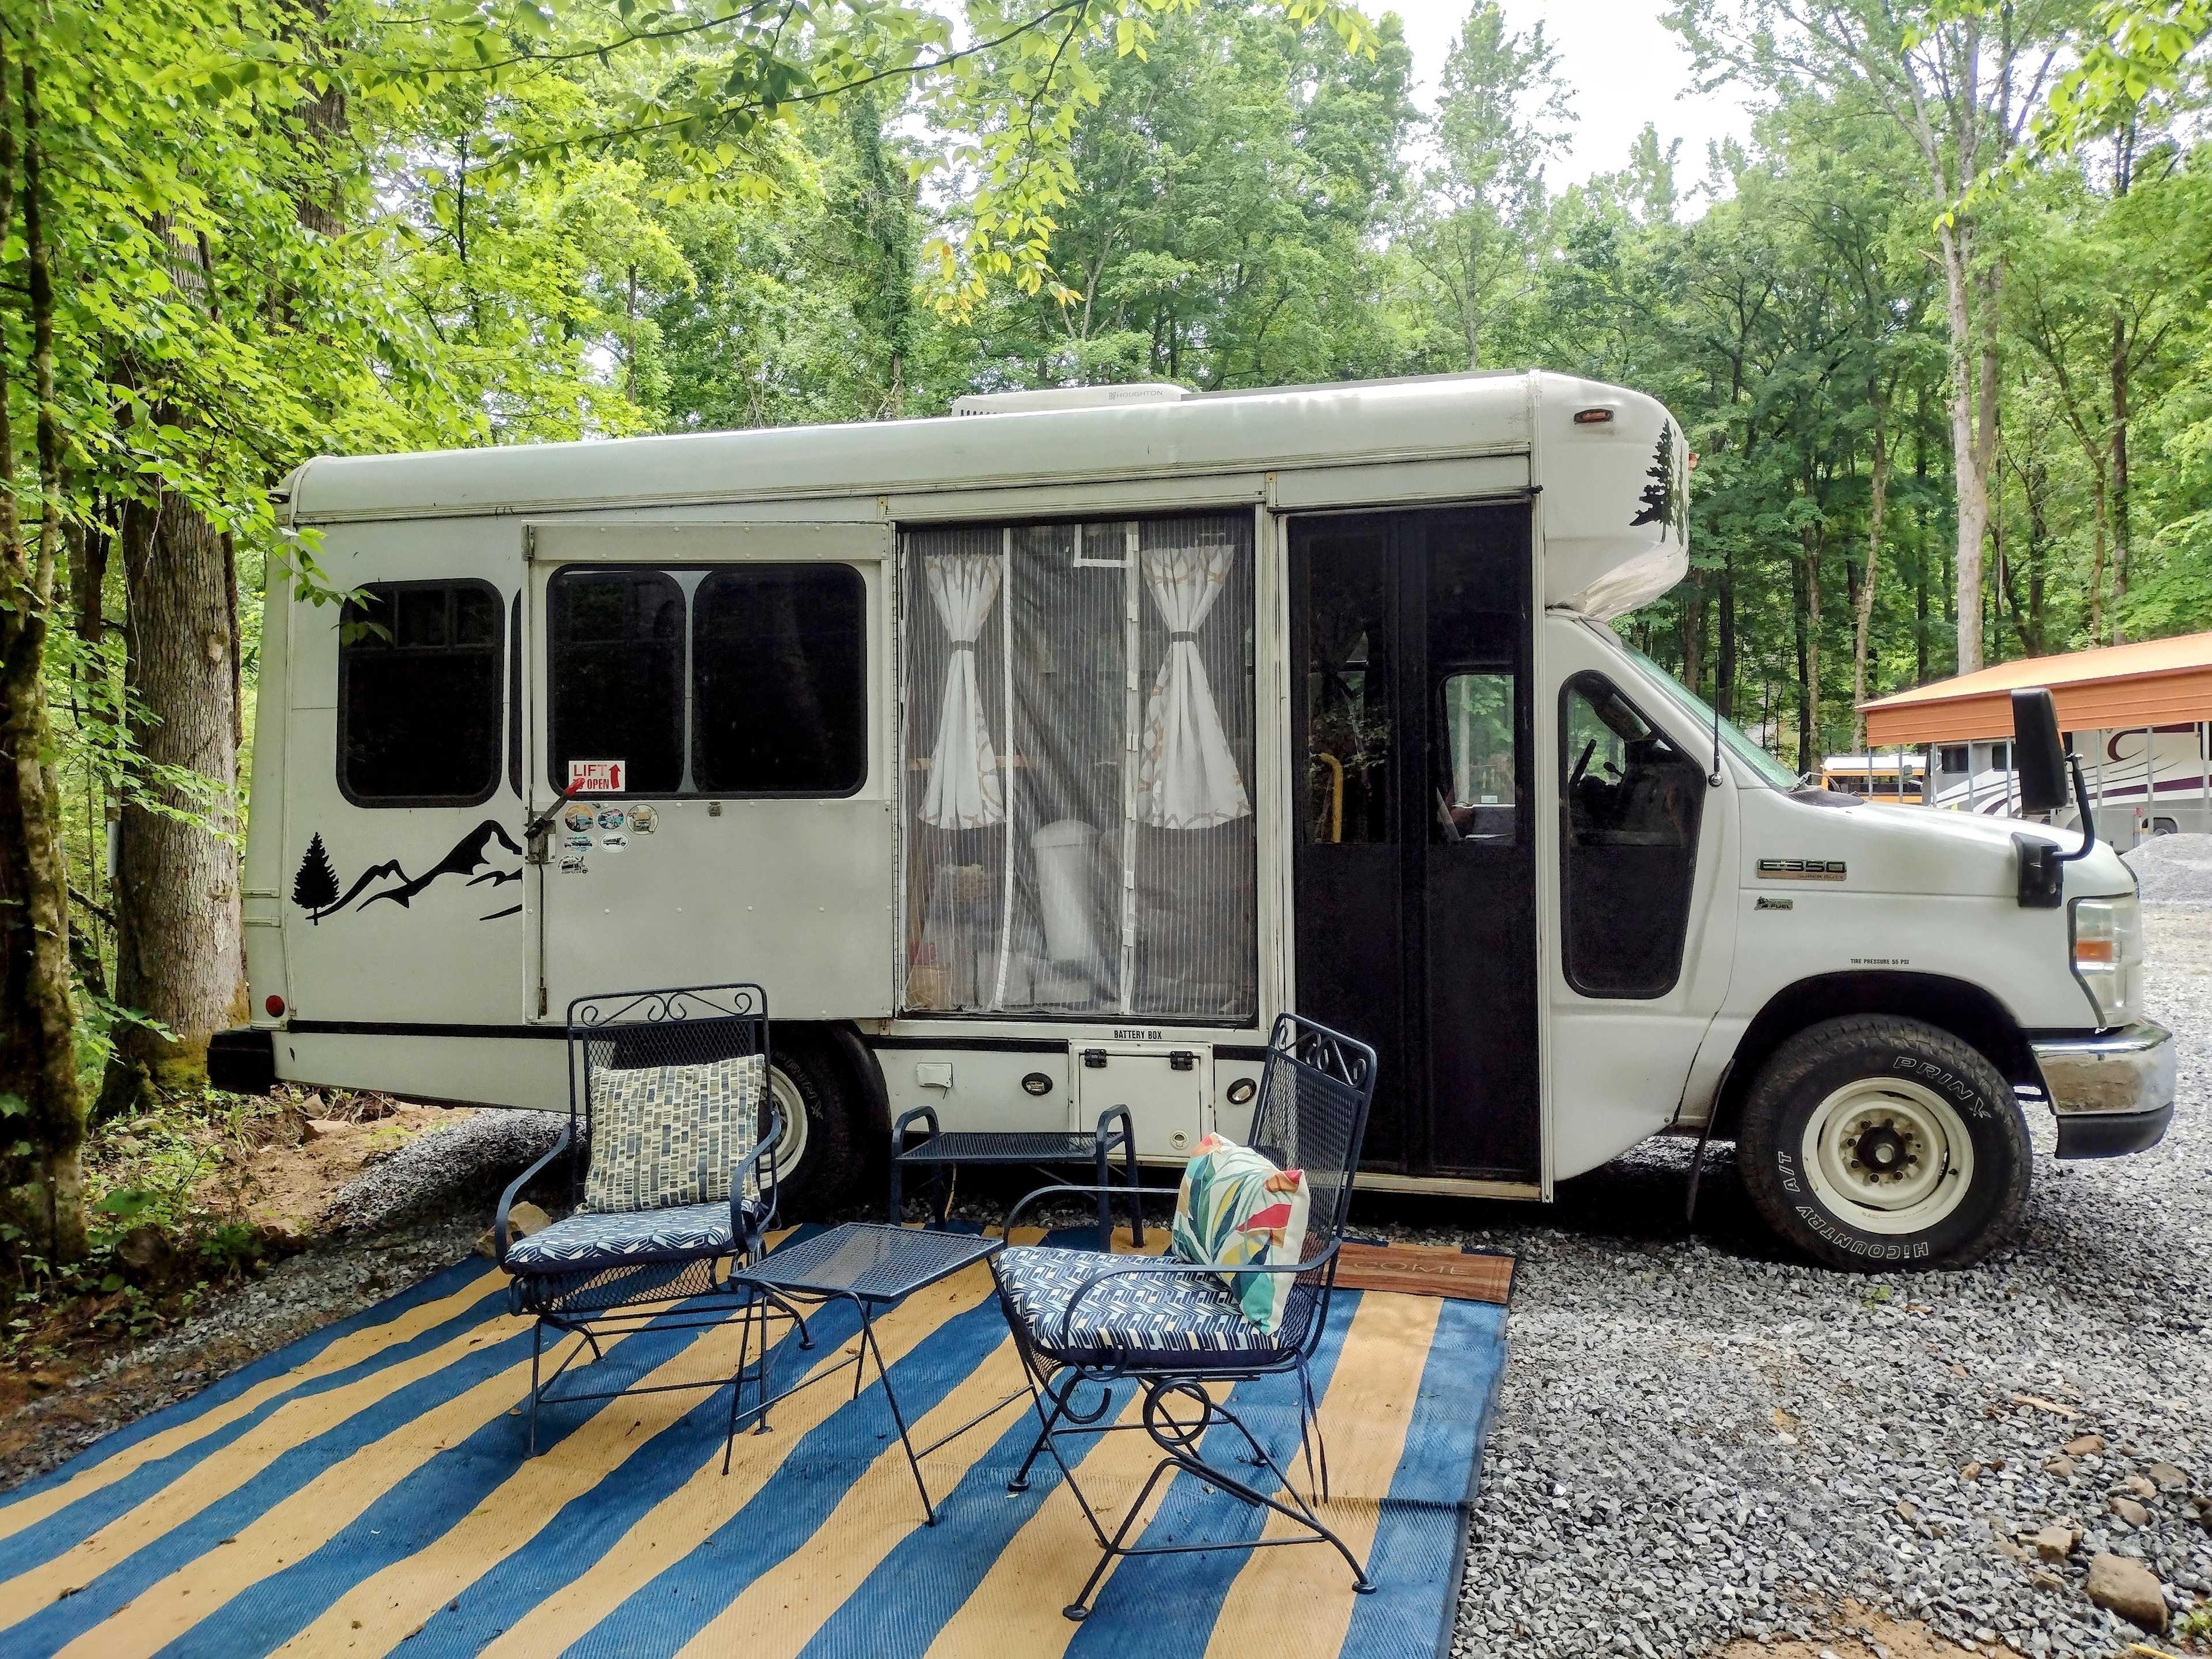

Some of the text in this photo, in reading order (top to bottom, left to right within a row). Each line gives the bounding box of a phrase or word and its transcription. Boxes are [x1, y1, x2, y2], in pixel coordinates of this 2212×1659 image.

[574, 764, 608, 777] LIFT
[587, 779, 609, 790] OPEN
[1113, 1030, 1162, 1040] BATTERY BOX
[1778, 1151, 1801, 1193] A/T
[1336, 1259, 1468, 1276] COME
